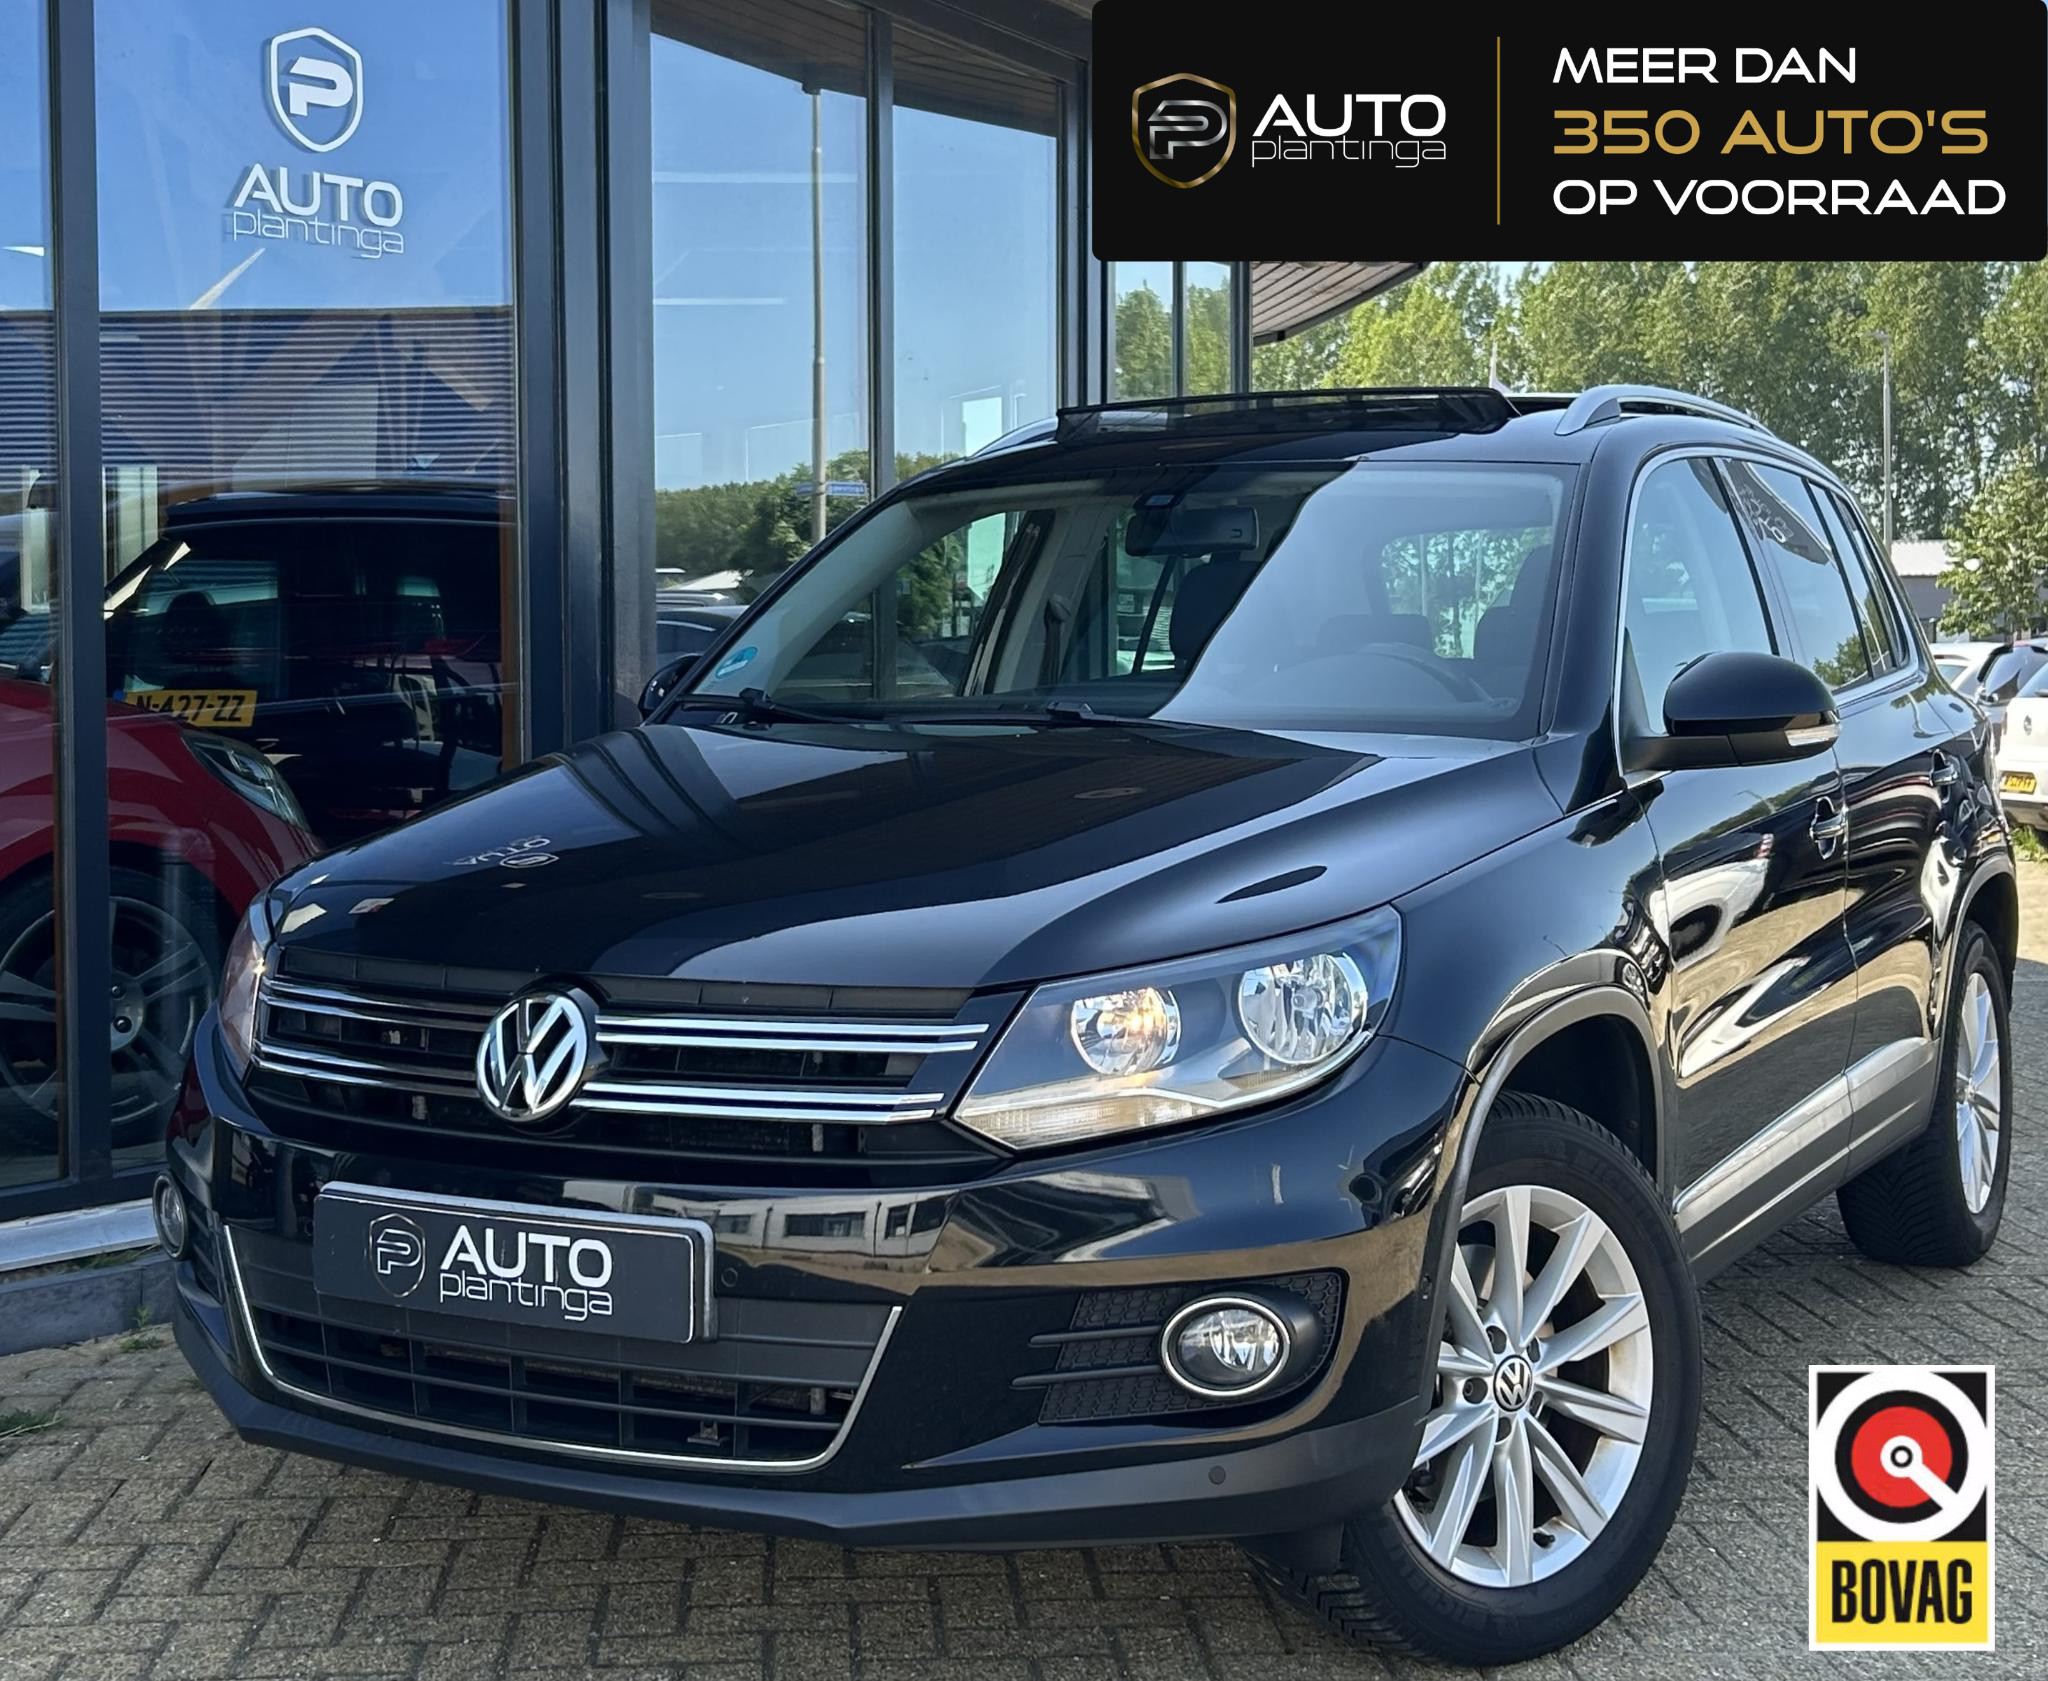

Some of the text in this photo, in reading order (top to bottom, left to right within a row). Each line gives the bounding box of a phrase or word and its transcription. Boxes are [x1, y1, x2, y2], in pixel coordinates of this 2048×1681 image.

[234, 163, 403, 227] AUTO
[233, 208, 404, 259] plantinga
[136, 694, 246, 722] N-427-ZZ
[440, 1224, 613, 1288] AUTO
[439, 1269, 613, 1322] plantinga
